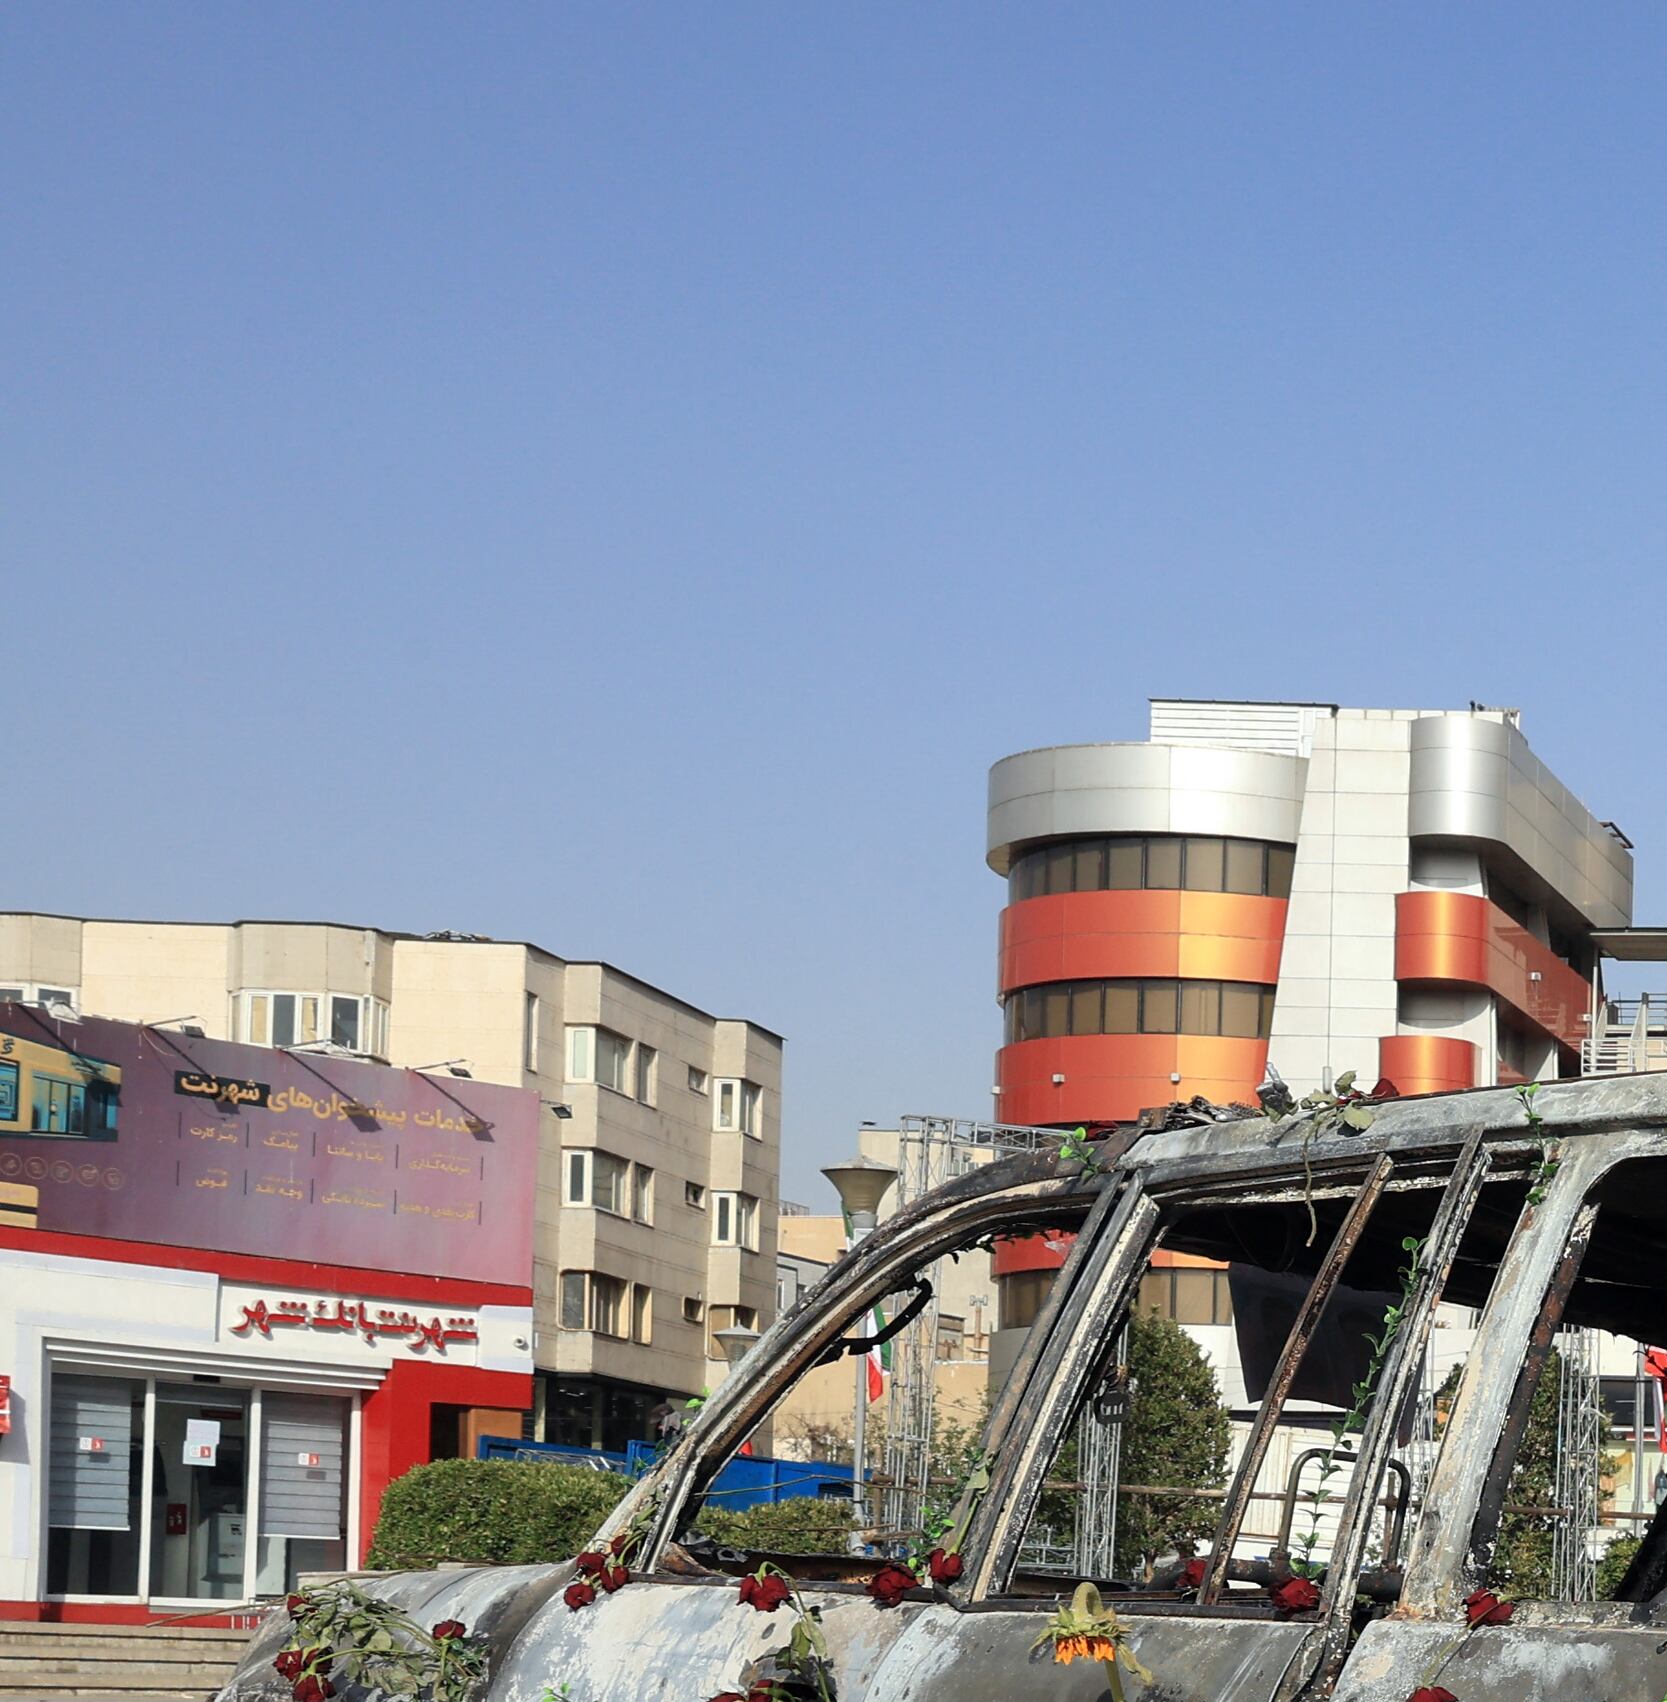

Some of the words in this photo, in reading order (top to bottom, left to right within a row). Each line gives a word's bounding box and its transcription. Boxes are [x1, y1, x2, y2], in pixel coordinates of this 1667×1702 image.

[180, 1072, 262, 1103] شهرنت
[267, 1085, 407, 1131] پیشوان‌های
[414, 1106, 482, 1134] دمات
[231, 1299, 306, 1334] شهر
[312, 1299, 376, 1342] بانک
[379, 1310, 479, 1350] شهرنت
